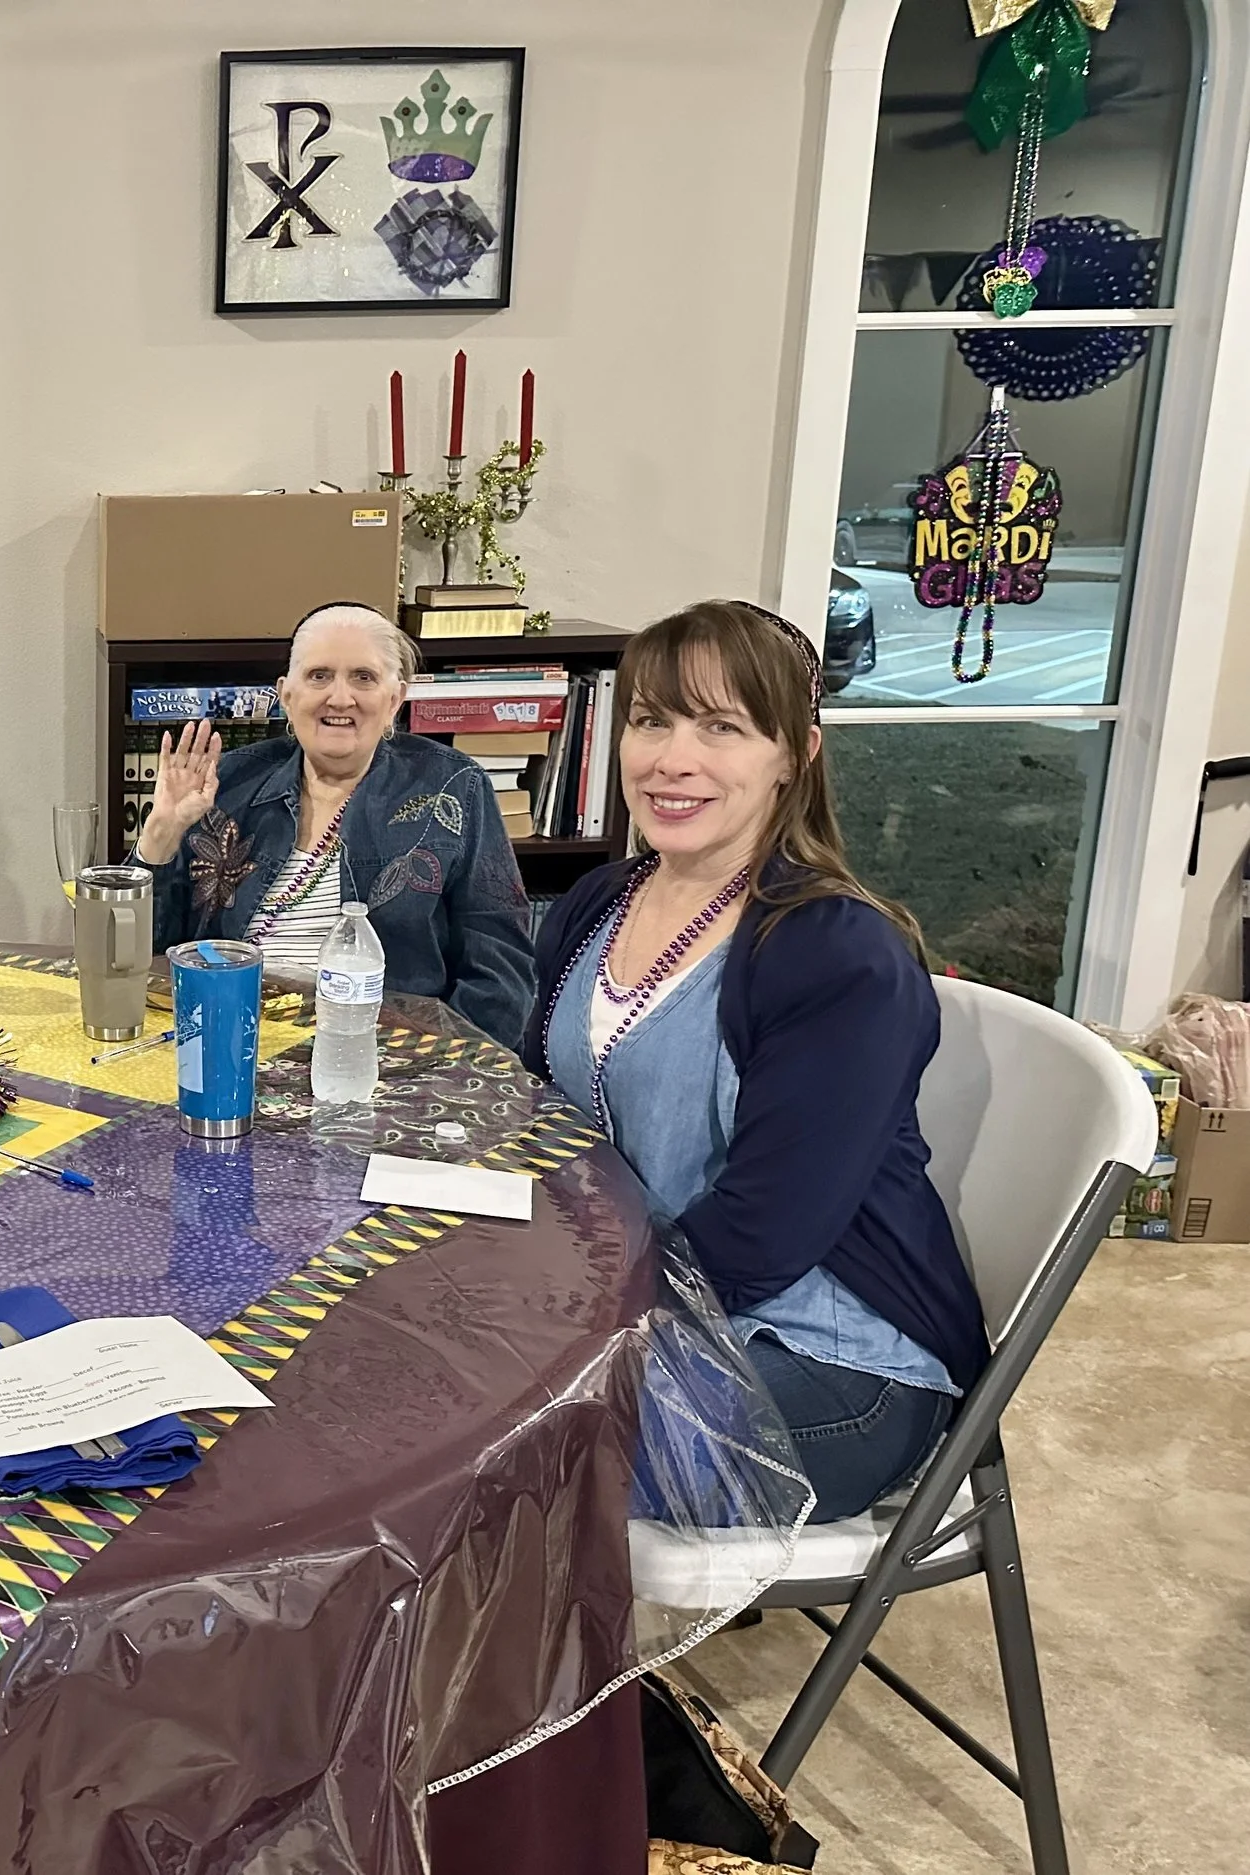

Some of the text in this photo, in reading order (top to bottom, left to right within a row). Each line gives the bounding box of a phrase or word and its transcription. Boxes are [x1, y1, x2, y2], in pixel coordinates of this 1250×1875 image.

[136, 691, 202, 707] No Stress
[148, 701, 193, 716] Chess
[73, 1366, 94, 1377] Decaf
